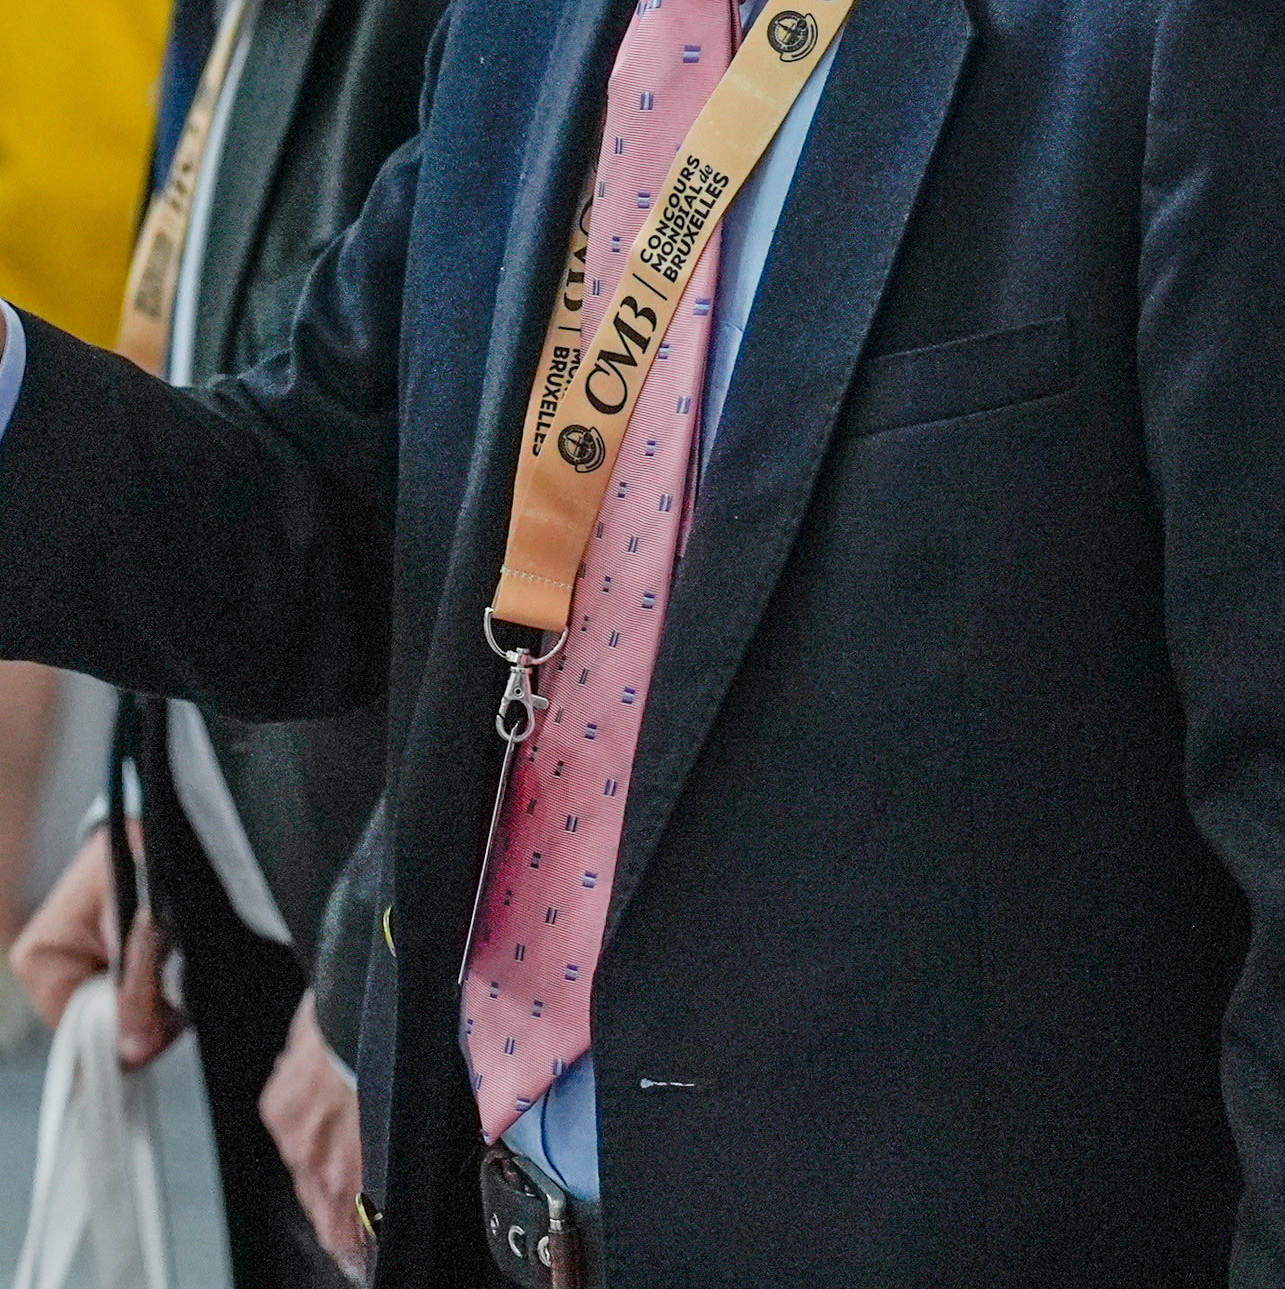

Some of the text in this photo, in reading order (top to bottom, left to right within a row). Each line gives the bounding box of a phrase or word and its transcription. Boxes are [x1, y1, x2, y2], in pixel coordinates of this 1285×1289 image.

[640, 155, 700, 264] CONCOURS
[650, 165, 713, 273] MONDIAL de
[662, 172, 730, 283] BRUXELLES
[585, 295, 657, 415] CMB
